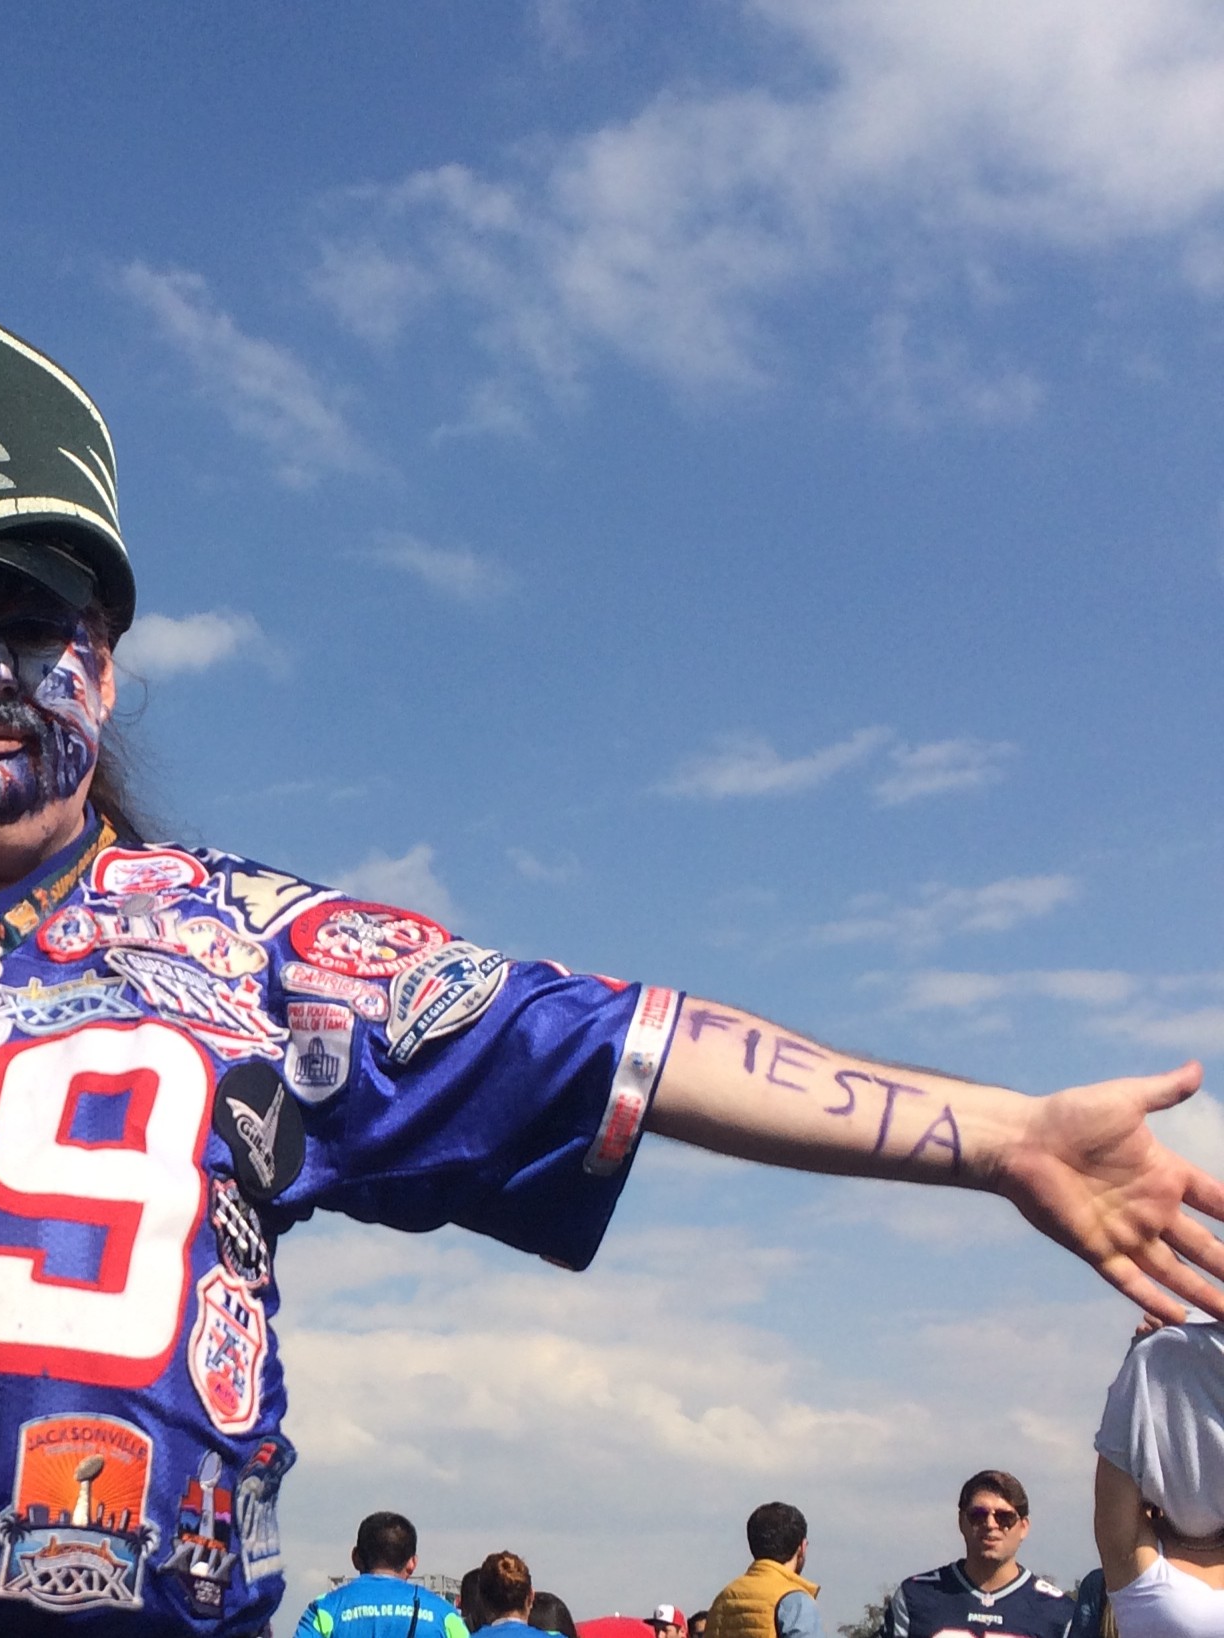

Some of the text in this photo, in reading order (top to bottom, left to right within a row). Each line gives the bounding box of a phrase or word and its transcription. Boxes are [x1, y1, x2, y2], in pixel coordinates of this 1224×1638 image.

[288, 1004, 352, 1019] PRO FOOTBALL
[416, 984, 465, 1032] REGULAR
[290, 1017, 349, 1031] HALL OF FAME
[685, 1010, 963, 1175] FIESTA
[26, 1426, 149, 1461] JACKSONVILLE
[341, 1604, 434, 1622] CONTROL DE ACCSOS
